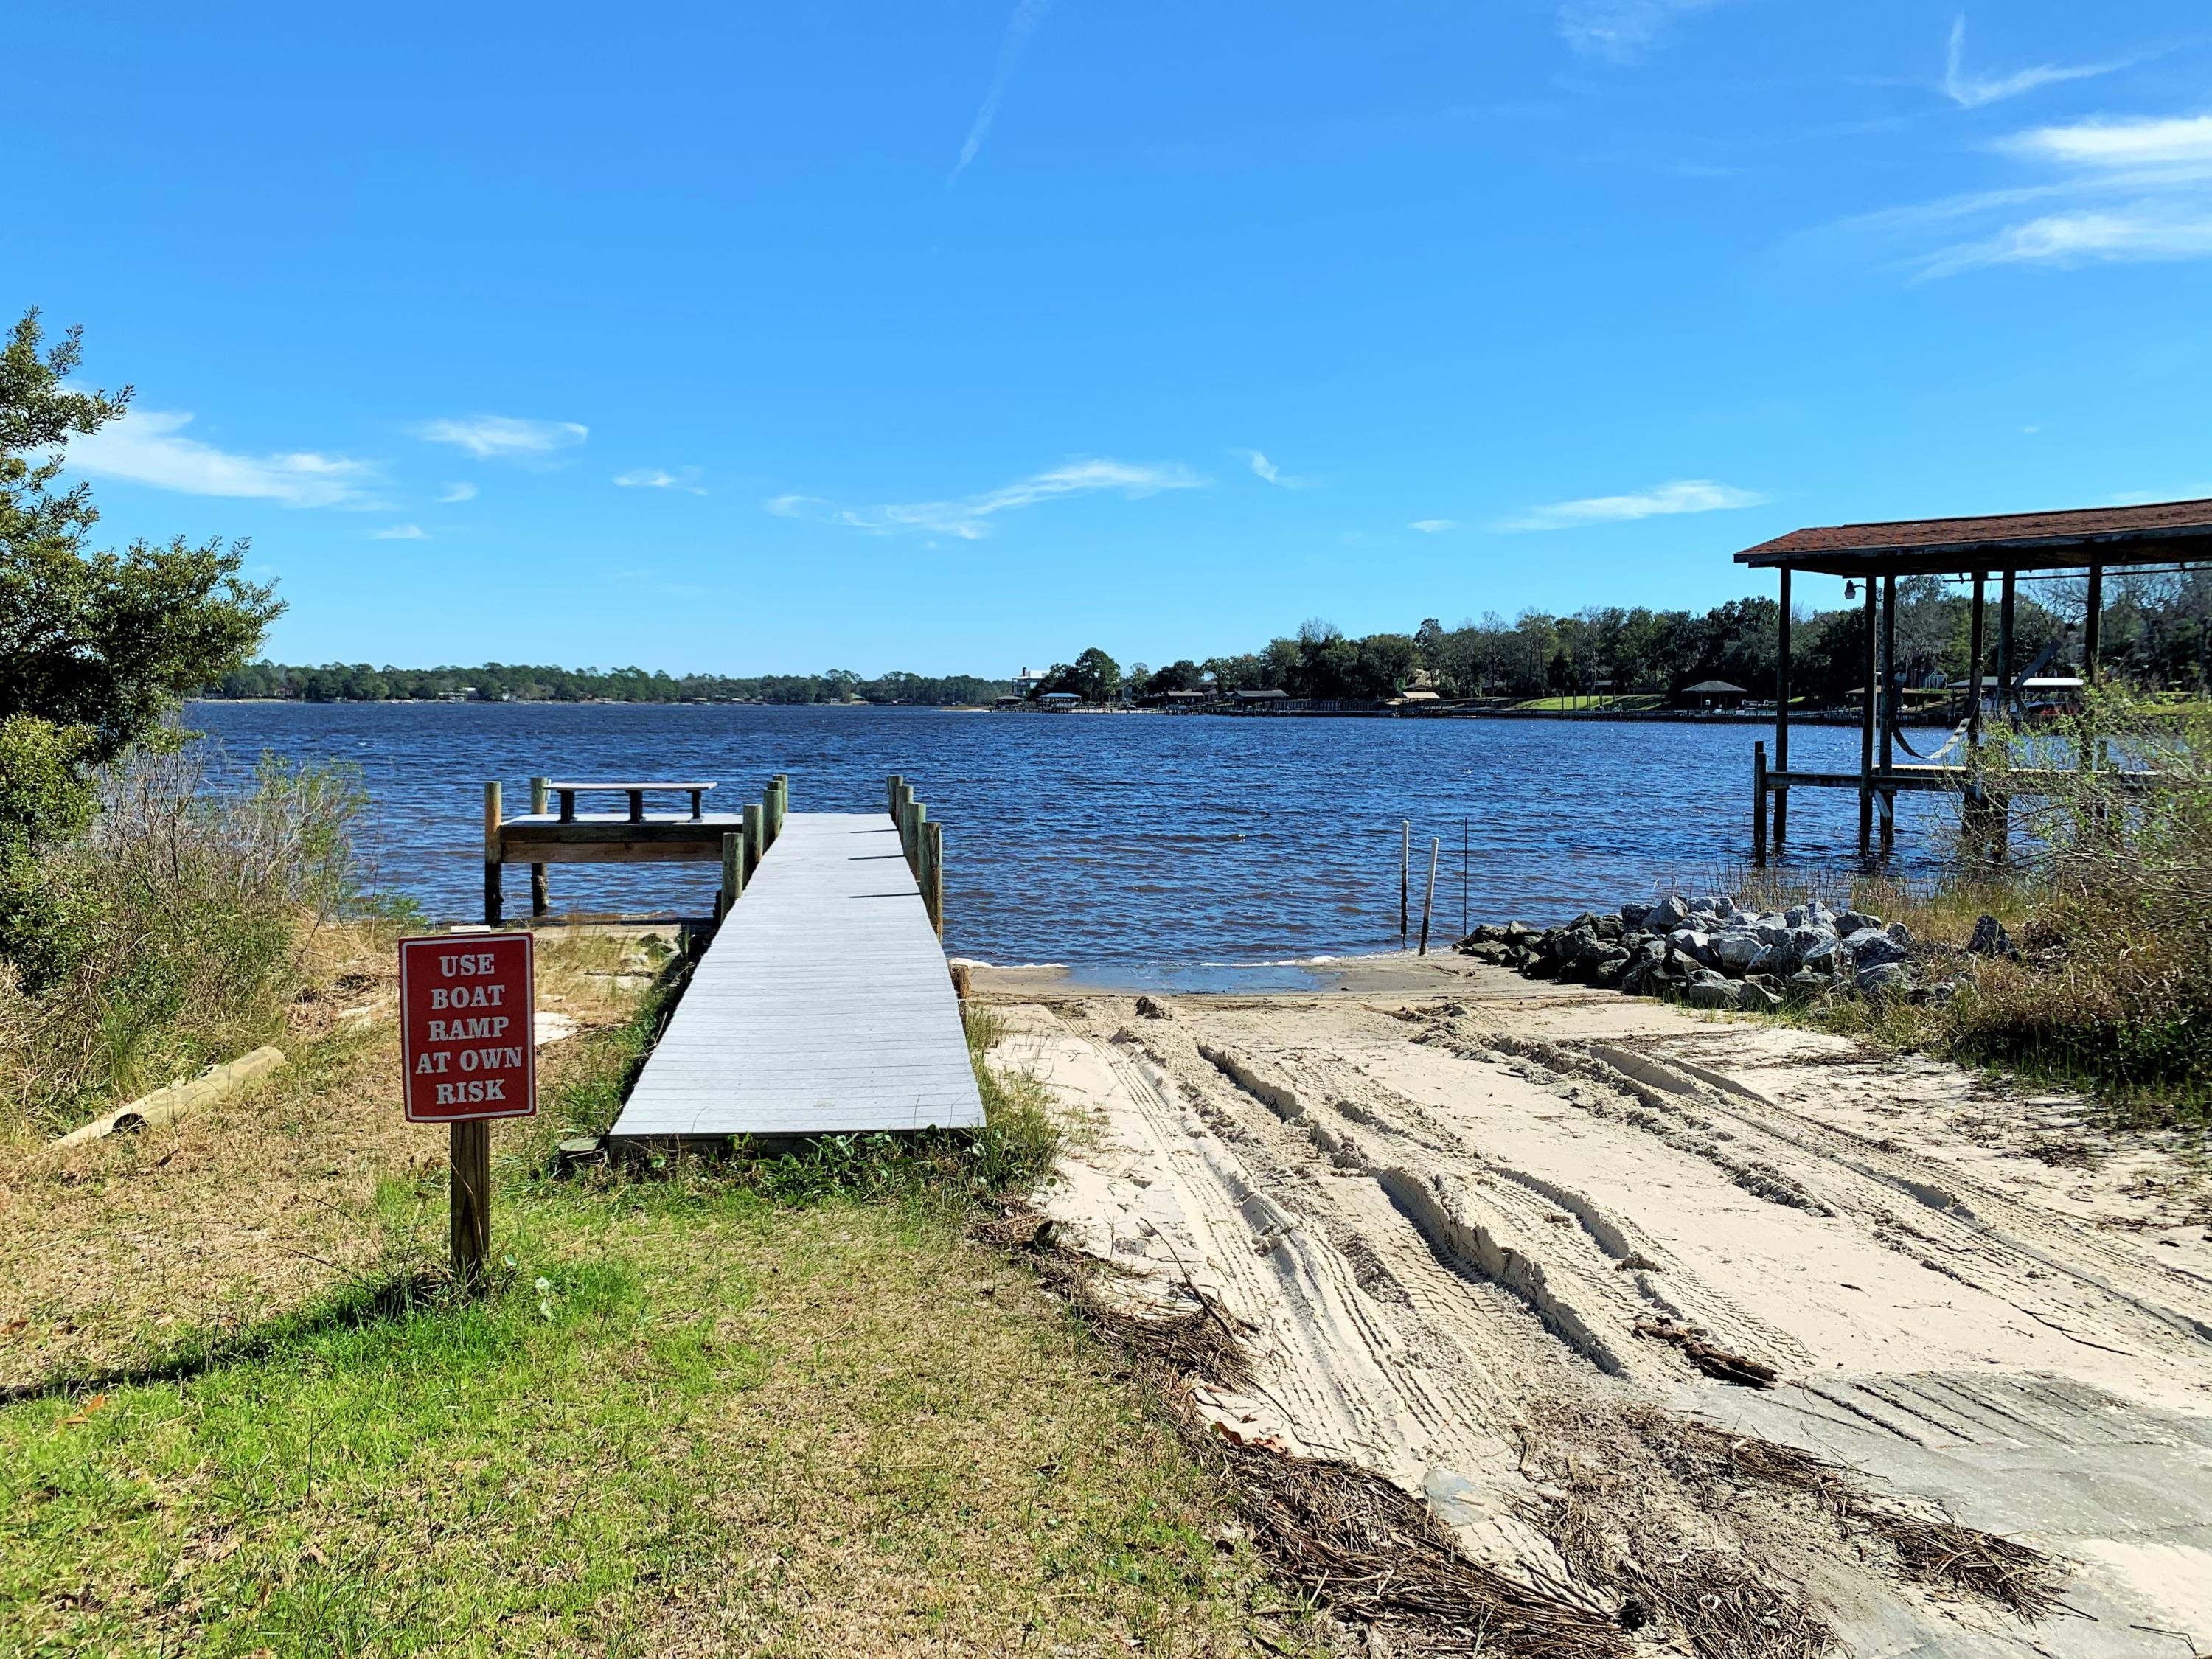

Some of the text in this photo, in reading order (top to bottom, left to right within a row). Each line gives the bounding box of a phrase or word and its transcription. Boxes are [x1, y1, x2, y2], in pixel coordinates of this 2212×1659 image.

[439, 953, 495, 977] USE
[431, 984, 506, 1009] BOAT
[428, 1016, 509, 1042] RAMP
[415, 1046, 523, 1074] AT OWN
[436, 1079, 506, 1105] RISK
